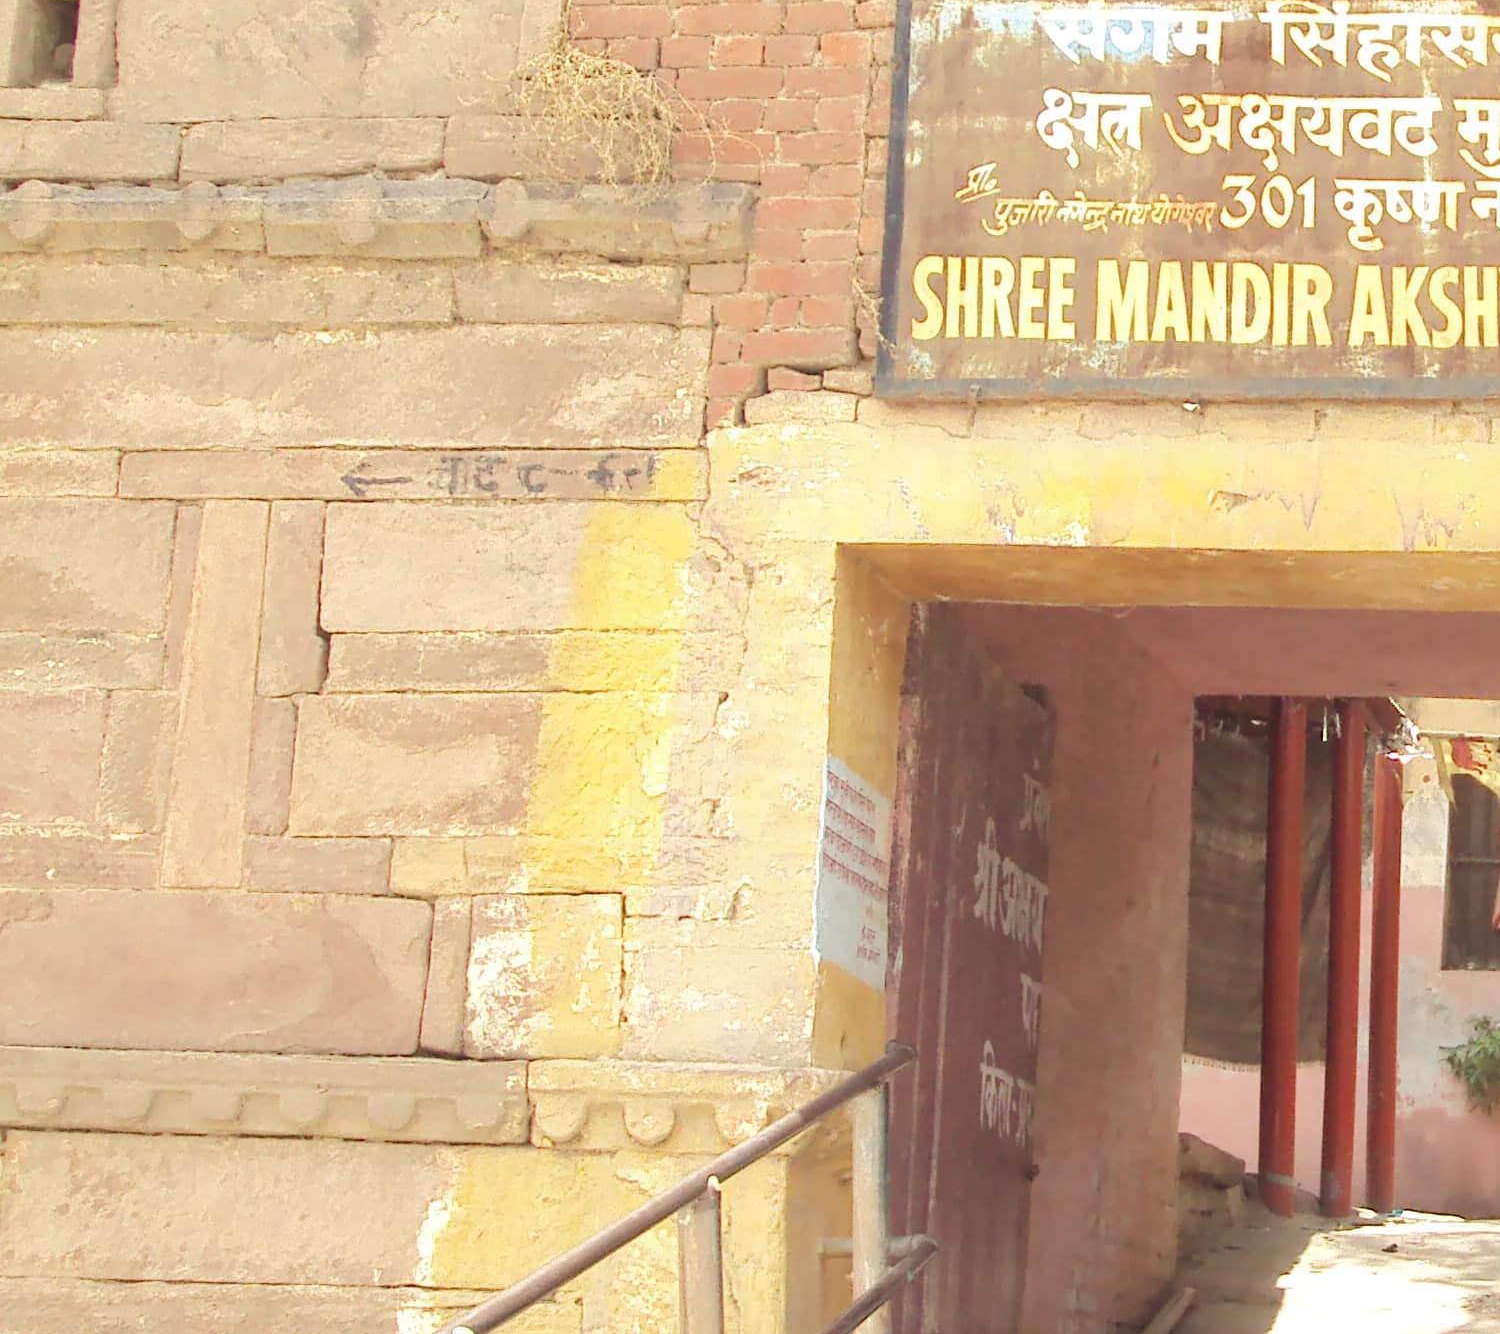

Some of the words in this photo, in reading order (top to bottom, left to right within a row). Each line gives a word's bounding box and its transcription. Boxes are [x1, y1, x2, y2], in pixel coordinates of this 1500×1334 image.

[1164, 94, 1442, 171] अक्षयवट
[1220, 174, 1317, 229] 301
[1334, 177, 1466, 250] कृष्ण
[911, 254, 1075, 341] SHREE
[1096, 259, 1334, 347] MANDIR
